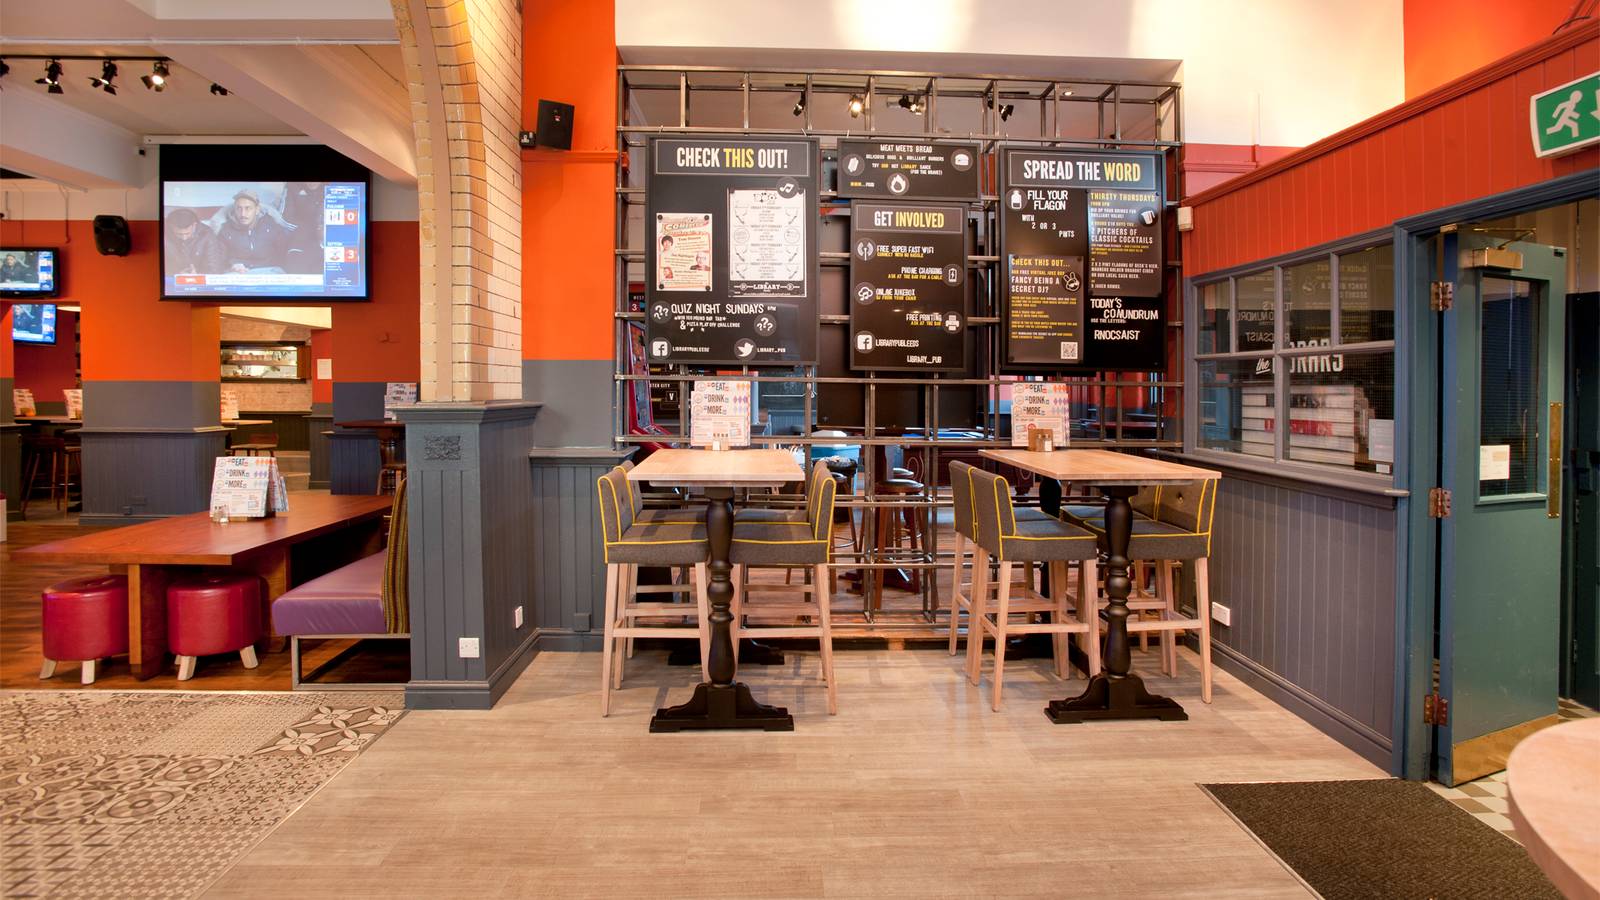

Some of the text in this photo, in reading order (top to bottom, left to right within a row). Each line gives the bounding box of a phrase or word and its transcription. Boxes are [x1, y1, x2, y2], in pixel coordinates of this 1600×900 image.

[880, 144, 933, 153] MEAT MEETS BREAD
[677, 147, 788, 169] CHECK THIS OUT!
[1023, 159, 1141, 182] SPREAD THE WORD
[1027, 190, 1069, 201] FILL YOUR
[1090, 192, 1156, 202] THIRSTY THURSDAYS
[1033, 200, 1066, 211] FLAGON
[874, 211, 945, 228] GET INVOLVED
[1021, 214, 1035, 222] WITH
[1031, 222, 1036, 230] 2
[1039, 222, 1047, 230] OR
[1058, 230, 1075, 238] PINTS
[1097, 227, 1128, 236] PITCHERS
[1129, 228, 1137, 236] OF
[1091, 235, 1153, 244] CLASSIC COCKTAILS
[877, 244, 889, 253] FREE
[891, 244, 908, 253] SUPER
[909, 245, 921, 254] FAST
[1011, 257, 1033, 266] CHECK
[1034, 258, 1049, 266] THIS
[901, 266, 942, 275] PHONE CHARGING
[1011, 276, 1060, 285] FANCY BEING A
[876, 288, 915, 296] ONLINE JUKEBOX
[1011, 285, 1036, 293] SECRET
[1090, 297, 1122, 309] TODAY'S
[671, 304, 692, 315] QUIZ
[696, 303, 721, 314] NIGHT
[726, 303, 764, 314] SUNDAYS
[906, 313, 942, 321] FREE PRINTING
[680, 320, 686, 330] &
[1093, 329, 1141, 341] RNOCSAIST
[715, 382, 725, 390] EAT
[1033, 384, 1043, 393] EAT
[707, 394, 725, 403] DRINK
[1028, 395, 1046, 404] DRINK
[707, 405, 722, 414] MORE
[1026, 406, 1041, 415] MORE
[229, 469, 246, 477] DRINK
[228, 480, 243, 488] MORE
